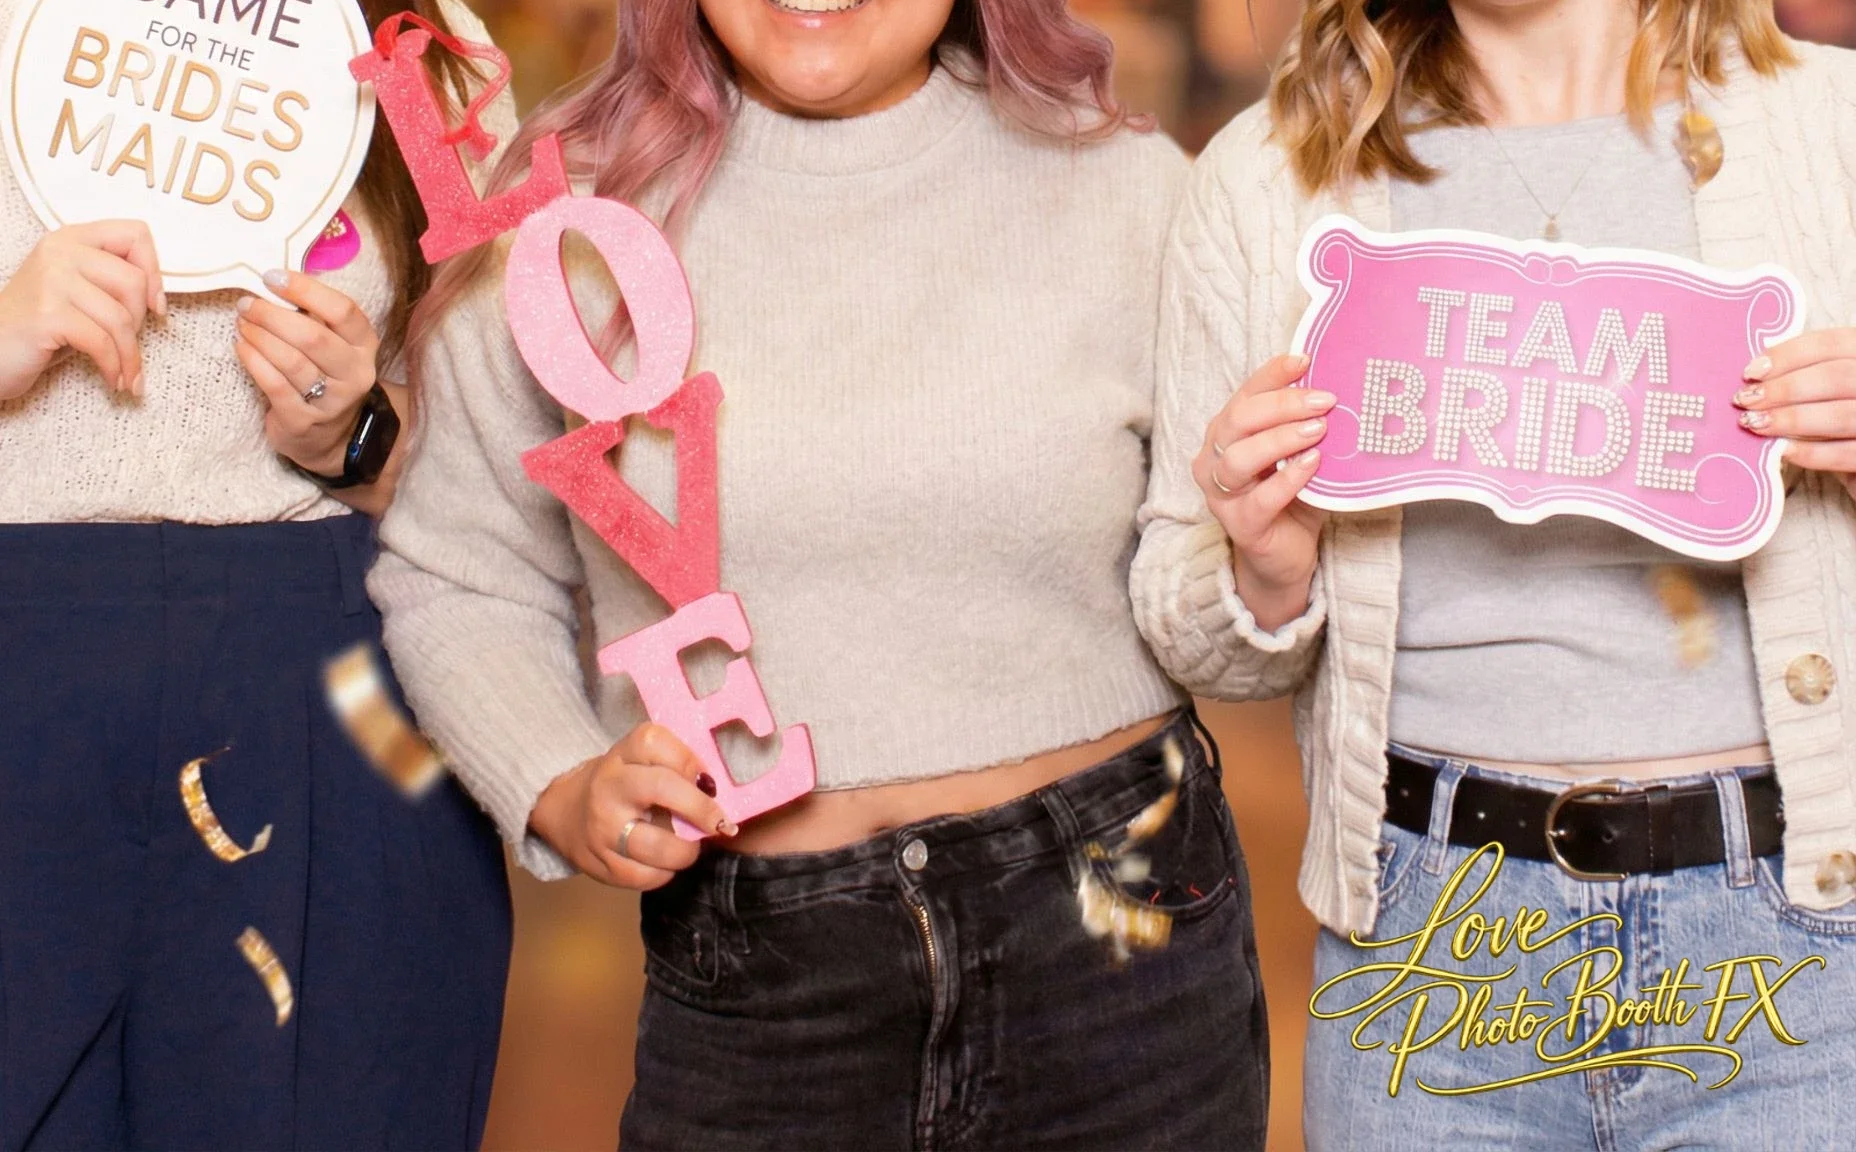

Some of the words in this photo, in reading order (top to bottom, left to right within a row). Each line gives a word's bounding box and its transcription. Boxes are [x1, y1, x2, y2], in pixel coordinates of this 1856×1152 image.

[64, 26, 310, 151] BRIDES
[146, 20, 198, 53] FOR
[207, 38, 255, 71] THE
[48, 99, 281, 222] MAIDS
[1416, 286, 1669, 385] TEAM
[349, 29, 817, 843] LOVE
[1357, 358, 1706, 493] BRIDE
